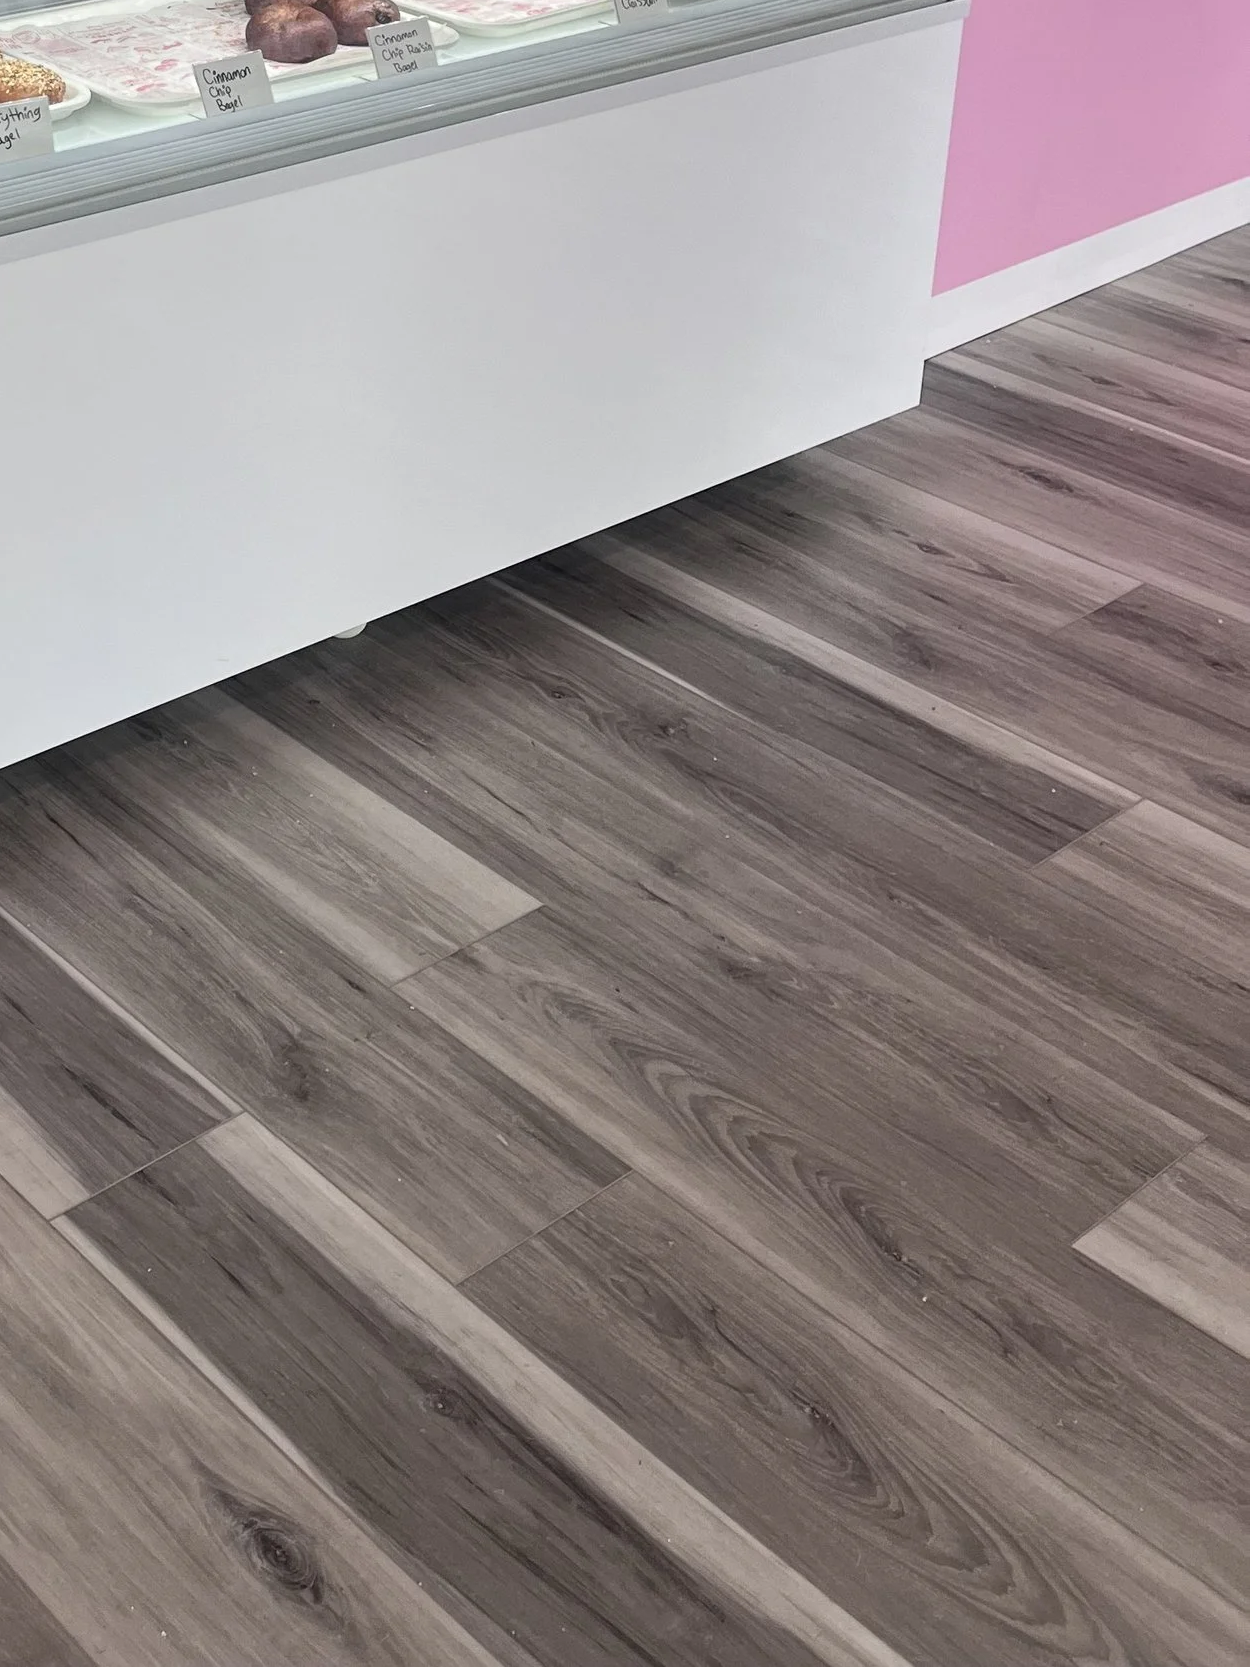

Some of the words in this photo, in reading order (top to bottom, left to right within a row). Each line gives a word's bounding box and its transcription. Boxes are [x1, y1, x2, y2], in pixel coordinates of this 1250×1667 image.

[373, 28, 420, 47] Cinnamon
[380, 46, 405, 62] Chip
[405, 40, 433, 55] Raisin
[202, 65, 252, 85] Cinnamon
[392, 59, 420, 74] Bagel
[208, 84, 232, 99] Chip
[215, 94, 244, 113] Bagel
